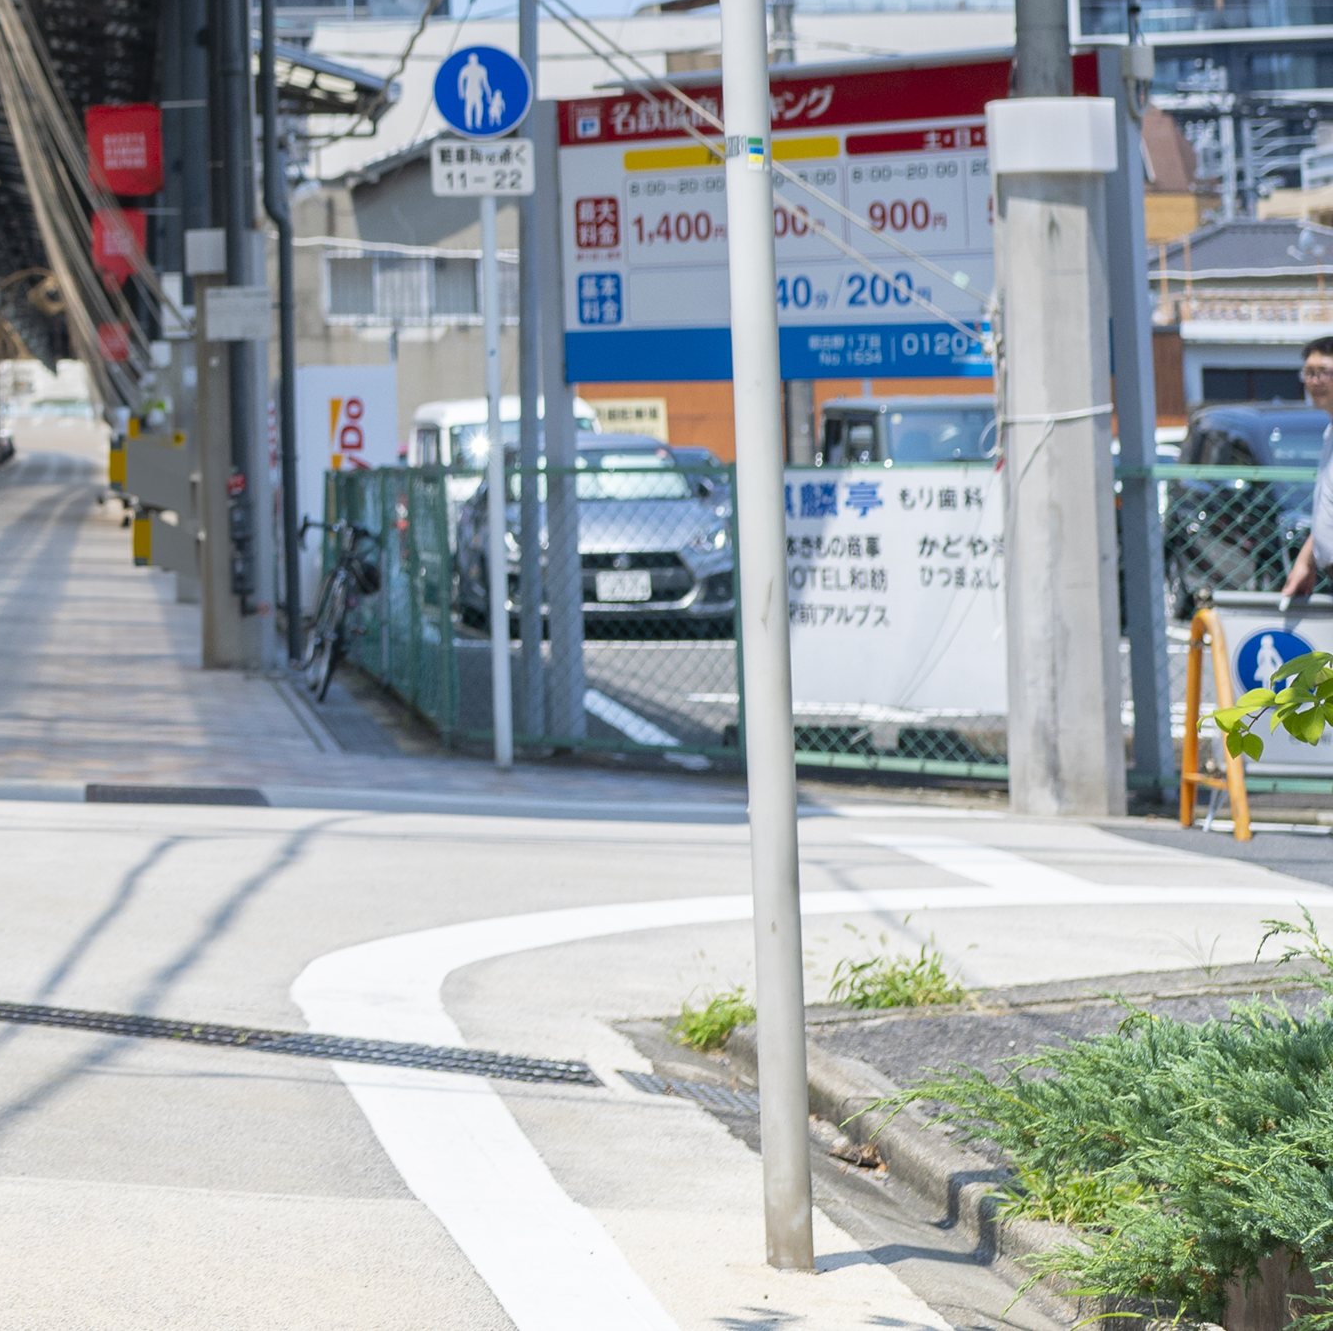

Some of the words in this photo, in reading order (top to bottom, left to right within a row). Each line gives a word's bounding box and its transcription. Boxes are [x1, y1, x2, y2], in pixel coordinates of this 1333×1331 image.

[610, 84, 834, 136] 名鉄協商キング
[922, 126, 987, 151] 土・日・
[899, 486, 983, 511] もり歯科
